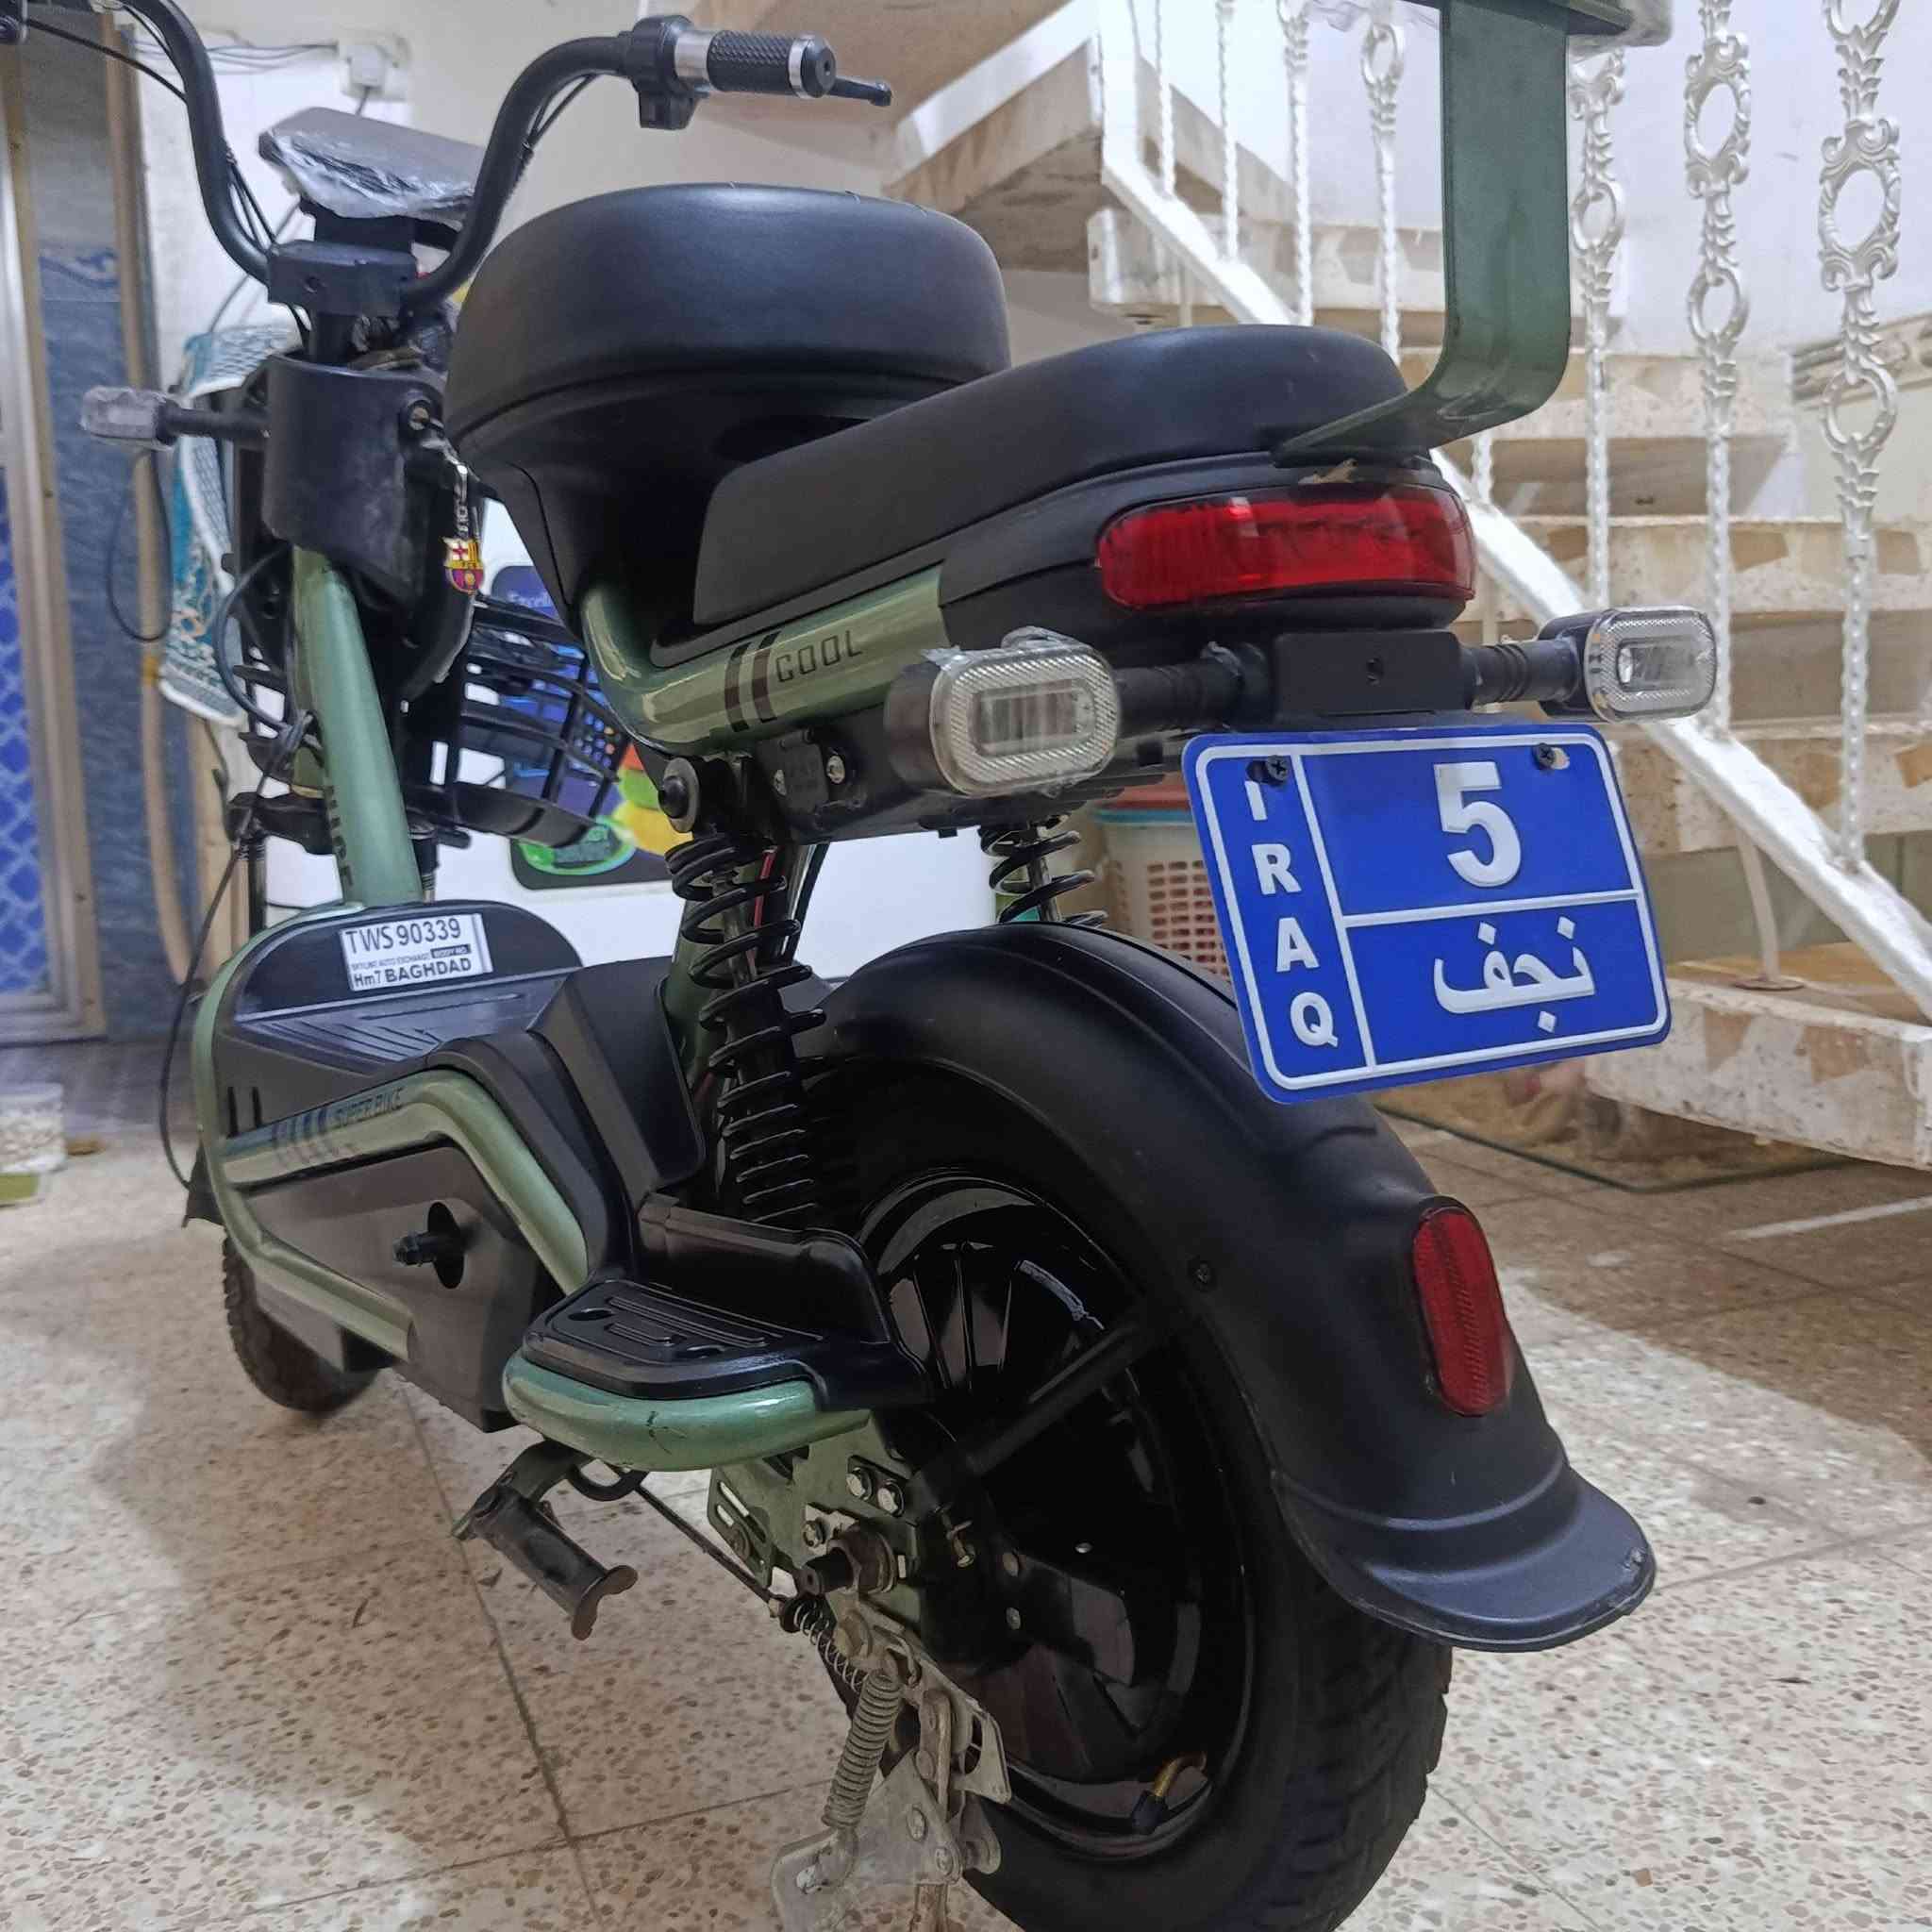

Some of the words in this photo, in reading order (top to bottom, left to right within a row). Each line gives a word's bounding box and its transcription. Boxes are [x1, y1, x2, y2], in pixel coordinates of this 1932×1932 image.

[775, 630, 863, 683] COOL
[1433, 761, 1522, 888] 5
[385, 958, 472, 983] BAGHDAD
[1244, 780, 1339, 1048] IRAQ
[1434, 916, 1595, 1033] نجف
